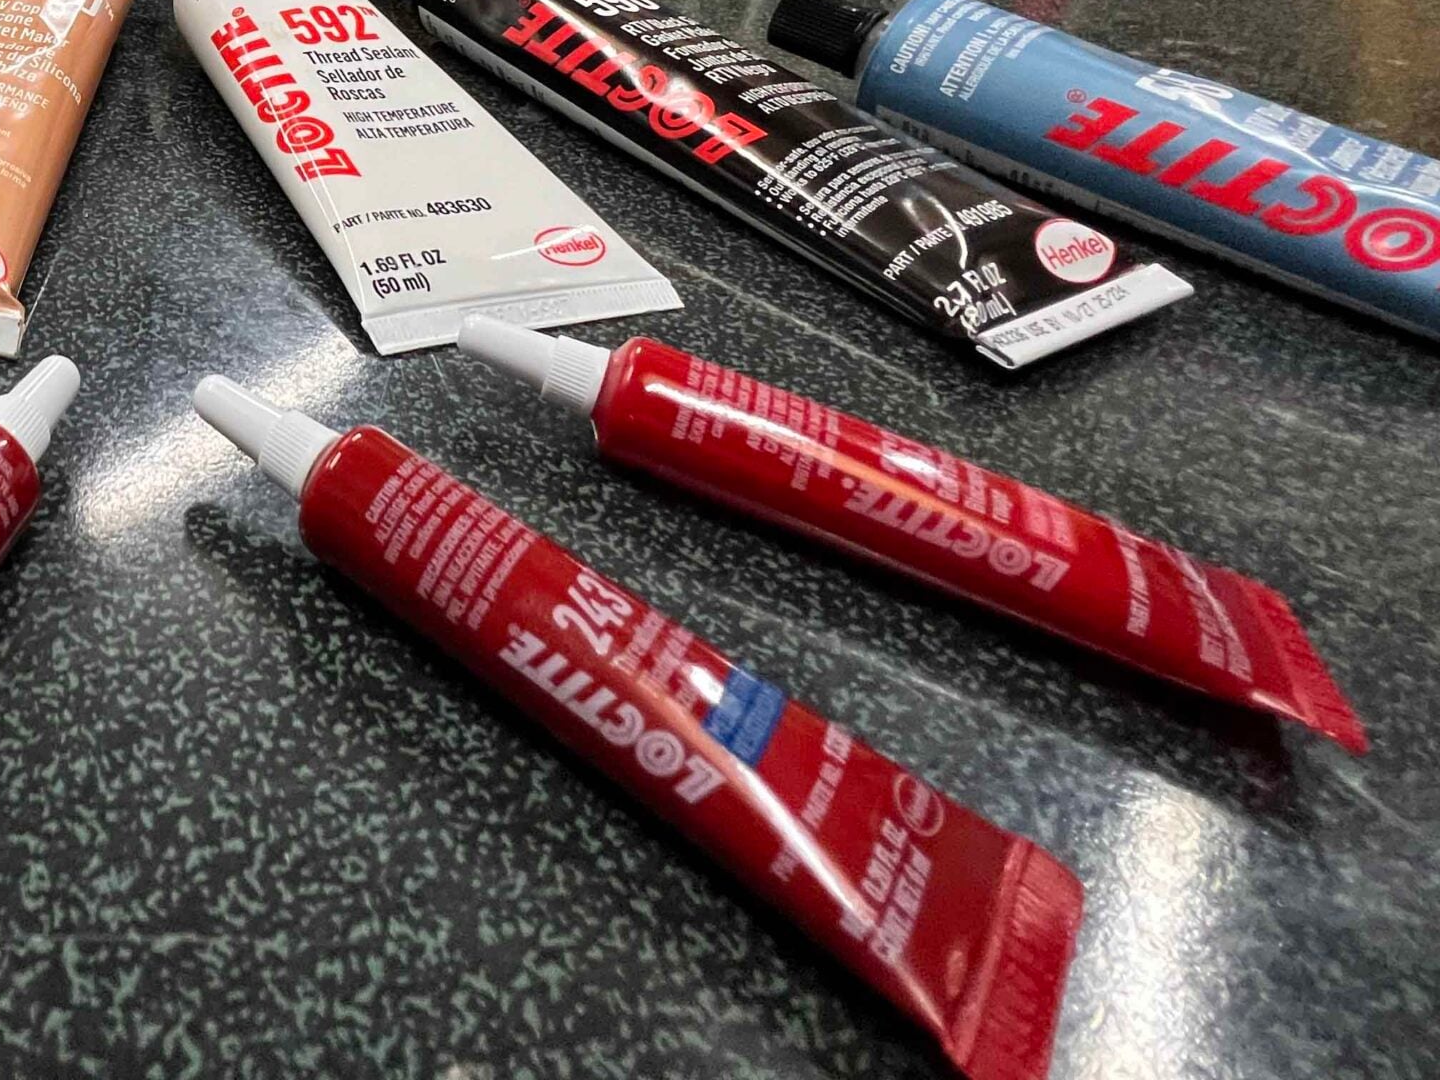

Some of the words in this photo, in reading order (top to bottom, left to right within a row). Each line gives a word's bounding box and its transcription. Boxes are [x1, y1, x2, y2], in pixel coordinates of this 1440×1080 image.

[279, 5, 380, 45] 592™
[620, 19, 653, 36] RTV
[641, 28, 687, 47] Gasket
[890, 24, 931, 74] CAUTION!
[989, 41, 1004, 57] DE
[303, 46, 362, 65] Thread
[363, 44, 421, 60] Sealant
[663, 41, 722, 60] Formador
[688, 52, 730, 72] Juntas
[317, 67, 383, 85] Sellador
[387, 65, 406, 79] de
[704, 65, 741, 84] RTV
[939, 32, 988, 97] ATTENTION
[29, 56, 81, 105] Silicona
[326, 85, 386, 102] Roscas
[738, 85, 766, 104] HIGH
[757, 96, 789, 115] ALTO
[343, 111, 375, 124] HIGH
[375, 101, 460, 122] TEMPERATURE
[355, 126, 388, 140] ALTA
[388, 117, 475, 139] TEMPERATURA
[0, 167, 27, 189] forma
[803, 170, 818, 180] to
[813, 152, 840, 172] 625°F
[828, 172, 851, 191] para
[333, 213, 364, 234] PART
[372, 207, 407, 221] PARTE
[407, 206, 427, 218] NO.
[426, 196, 492, 217] 483630
[883, 247, 914, 281] PART
[914, 221, 952, 252] PARTE
[1042, 233, 1107, 270] Henkel
[360, 256, 399, 278] 1.69
[422, 249, 447, 265] OZ
[987, 261, 1008, 287] OZ
[372, 277, 401, 300] (50
[403, 271, 431, 293] ml)
[844, 484, 1071, 593] LOCTITE
[431, 579, 454, 608] UNA
[551, 570, 634, 656] 243
[499, 628, 729, 805] LOCTITE
